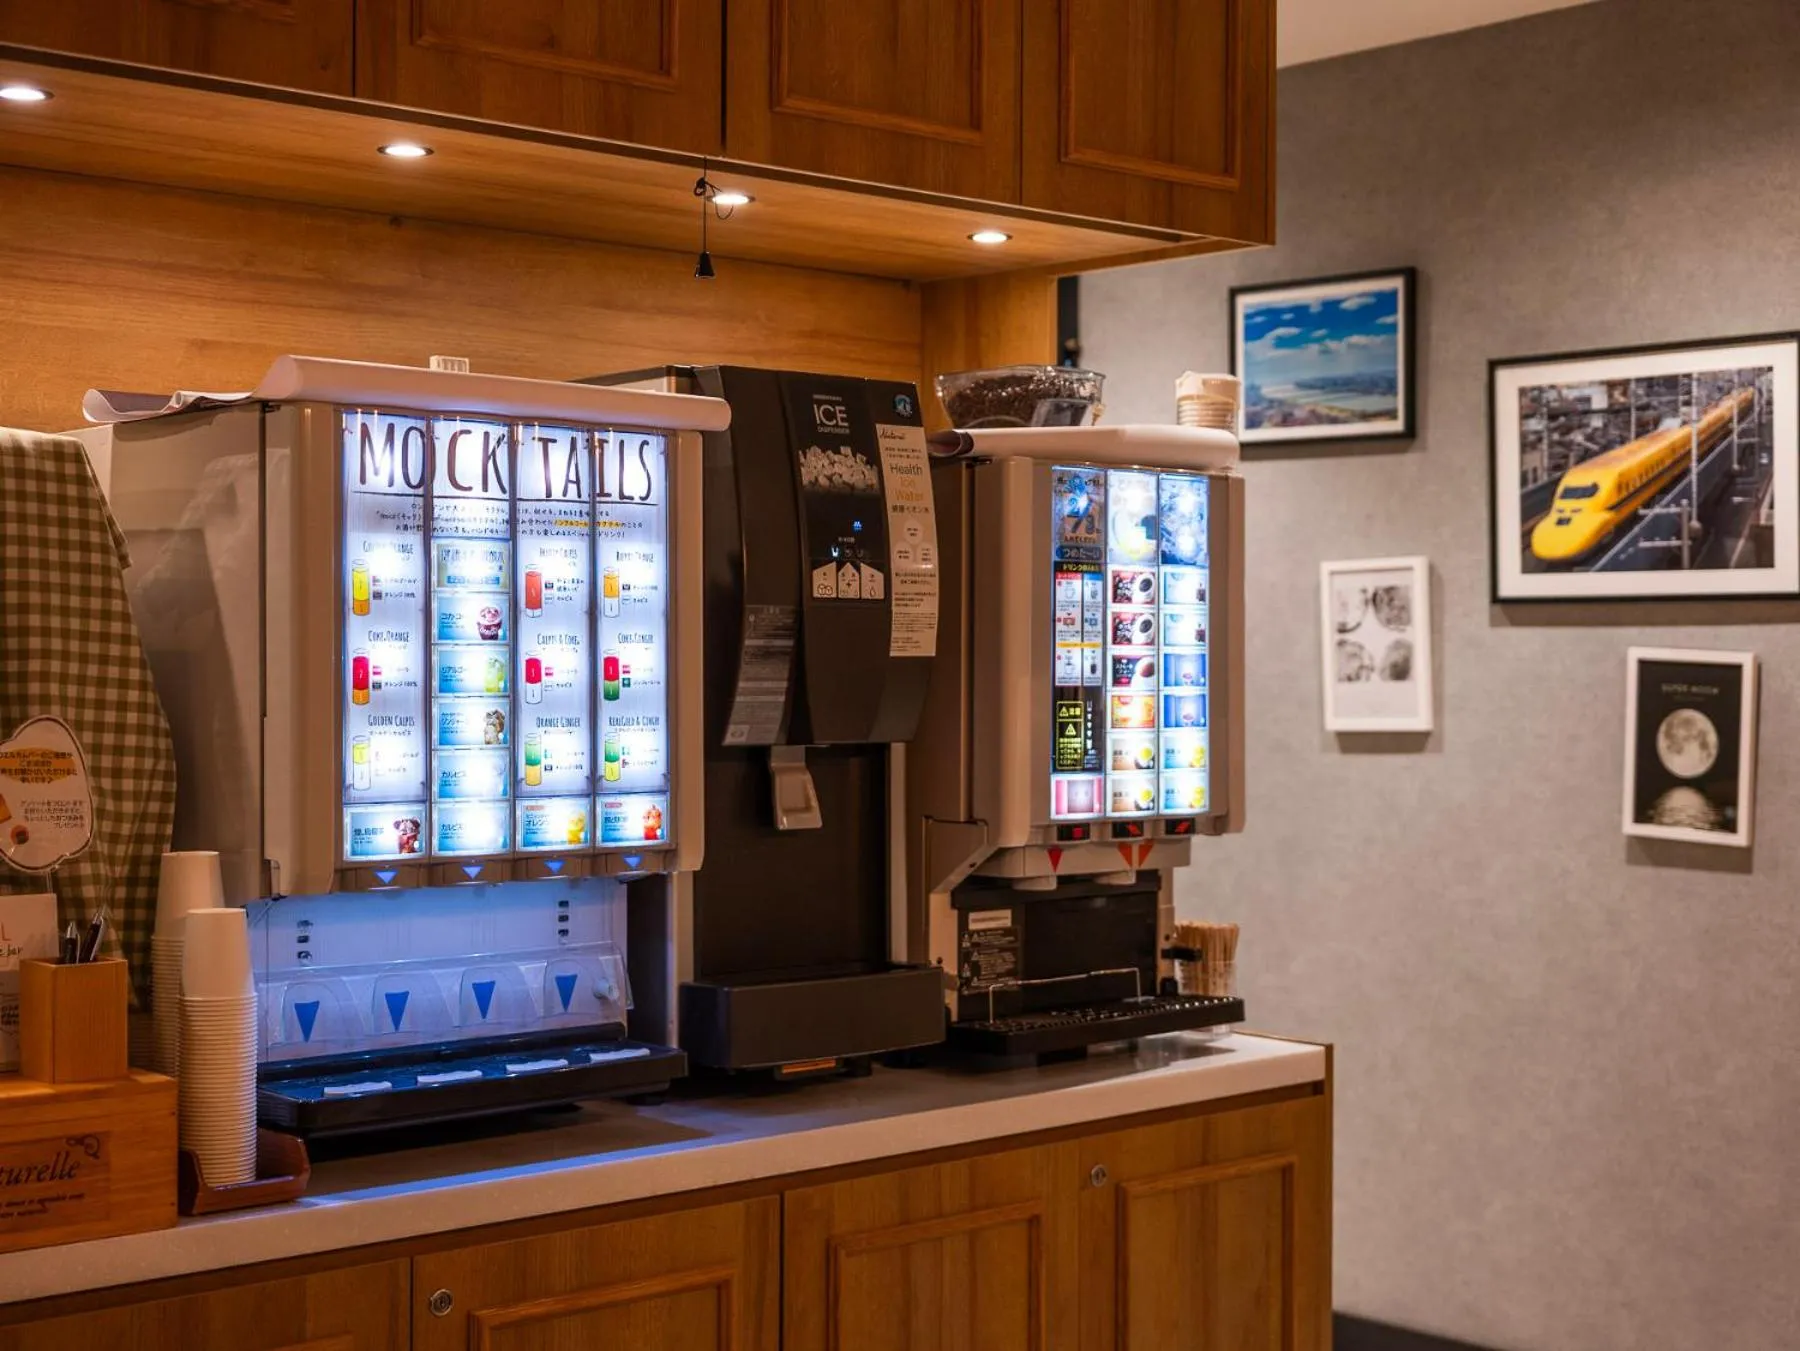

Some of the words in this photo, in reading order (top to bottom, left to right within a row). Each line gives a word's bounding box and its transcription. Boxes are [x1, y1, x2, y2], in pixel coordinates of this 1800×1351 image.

[813, 403, 849, 427] ICE
[890, 463, 922, 476] Health
[368, 714, 393, 727] GOLDEN
[395, 714, 415, 727] CALPIS
